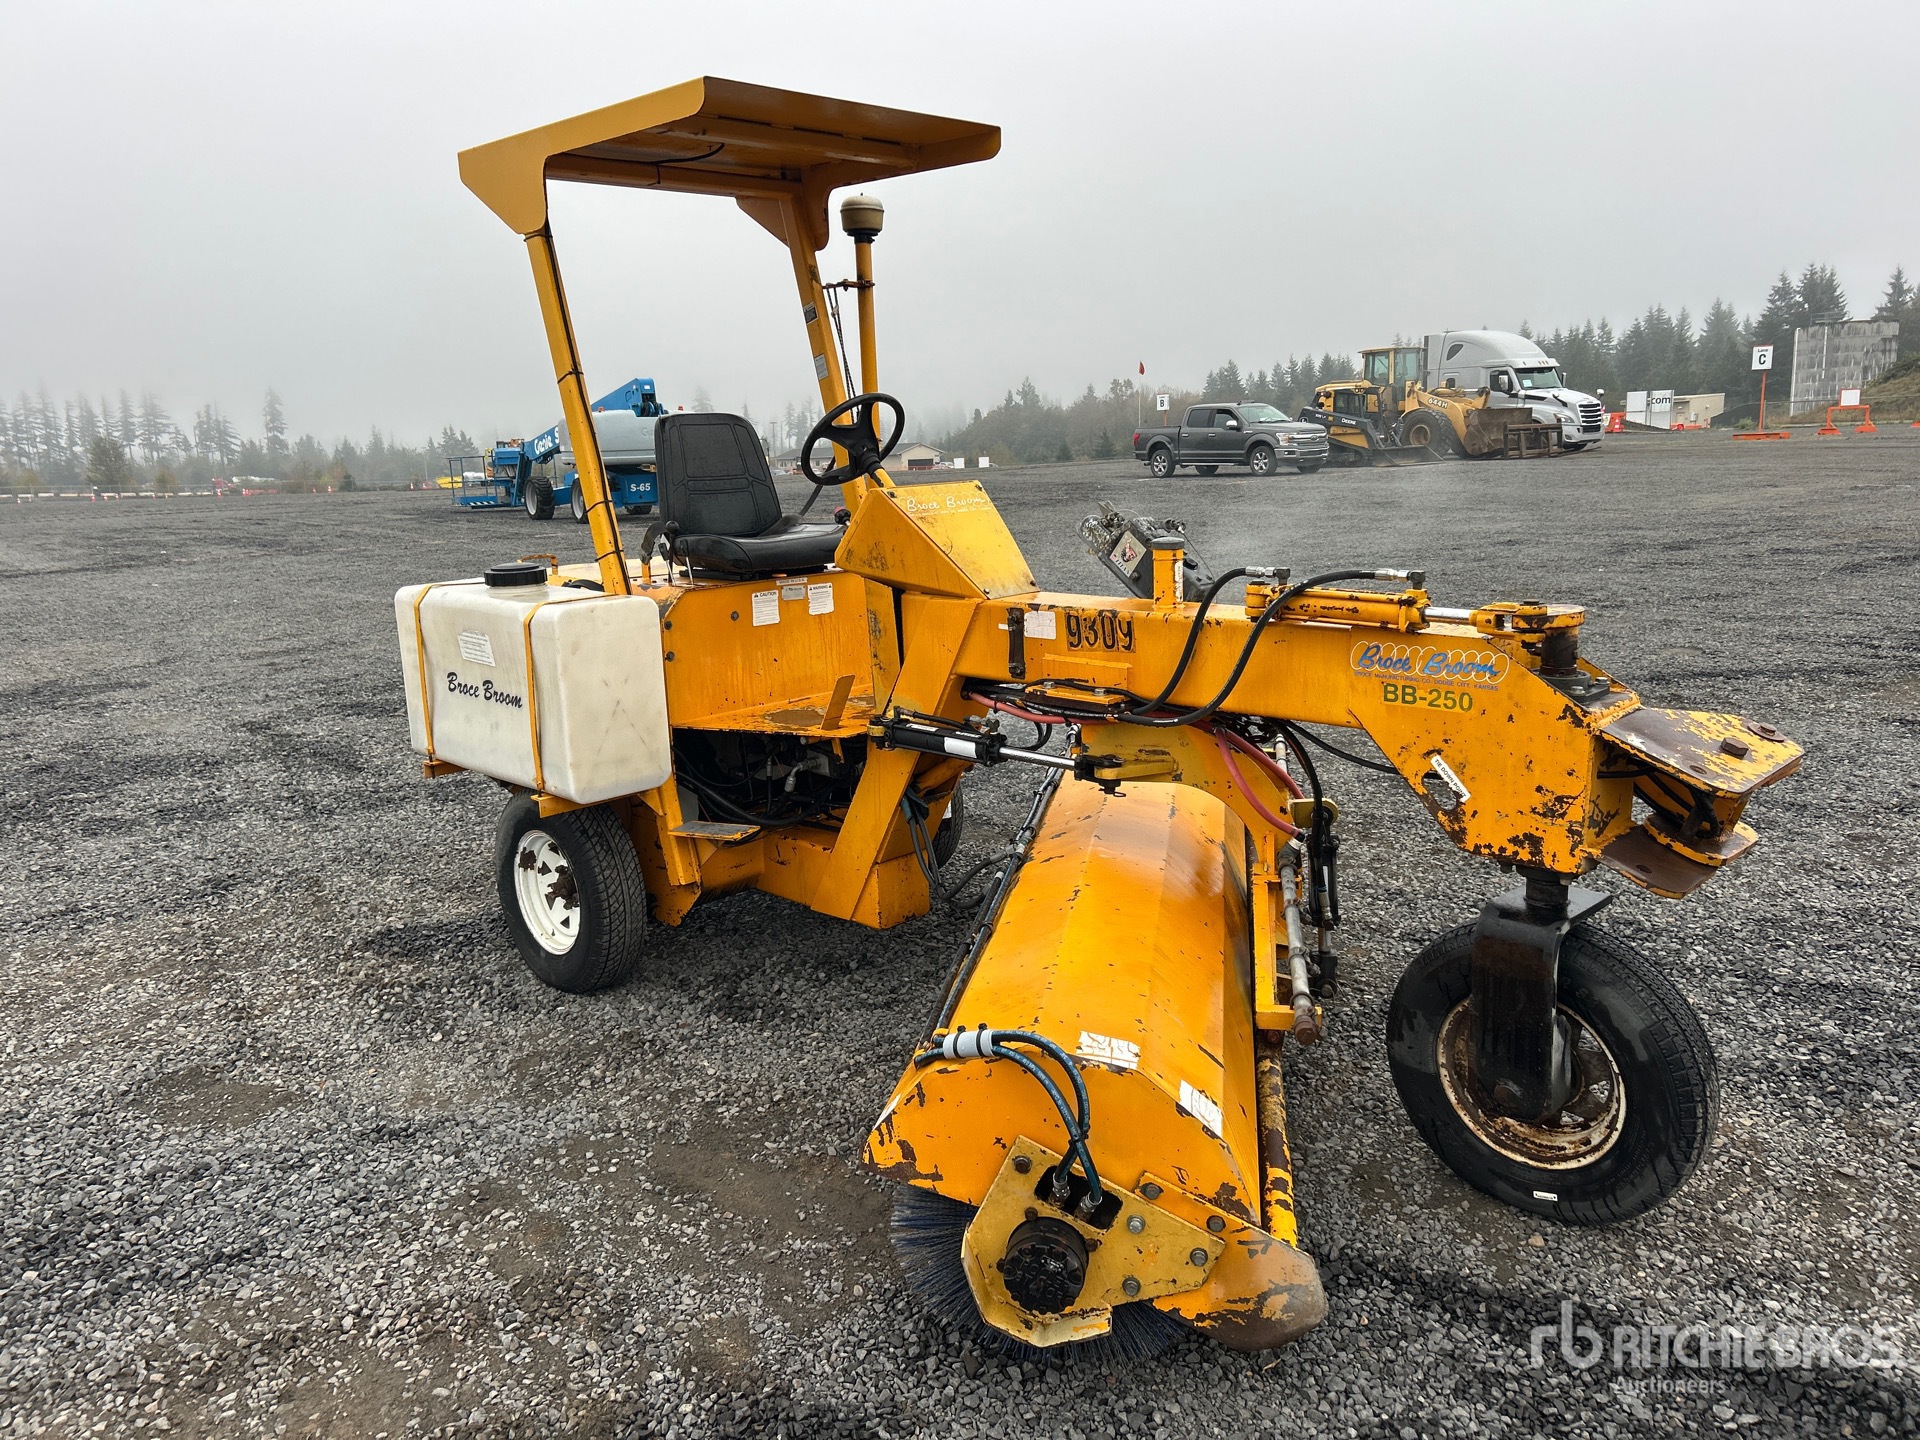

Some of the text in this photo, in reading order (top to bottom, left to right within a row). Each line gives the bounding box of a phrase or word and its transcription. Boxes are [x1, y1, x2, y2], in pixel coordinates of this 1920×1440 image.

[1758, 353, 1767, 365] C
[1428, 397, 1448, 409] 644H
[1341, 417, 1357, 425] DEERE
[630, 482, 651, 492] S-65
[907, 497, 940, 512] Broce
[946, 495, 986, 508] Broom
[1066, 613, 1134, 651] 9309
[1357, 644, 1501, 676] Broce Broom
[447, 672, 523, 708] Broce Broom
[1434, 679, 1454, 687] DODGE
[1473, 683, 1499, 691] KANSAS
[1383, 683, 1474, 712] BB-250
[1440, 766, 1455, 783] DOWN
